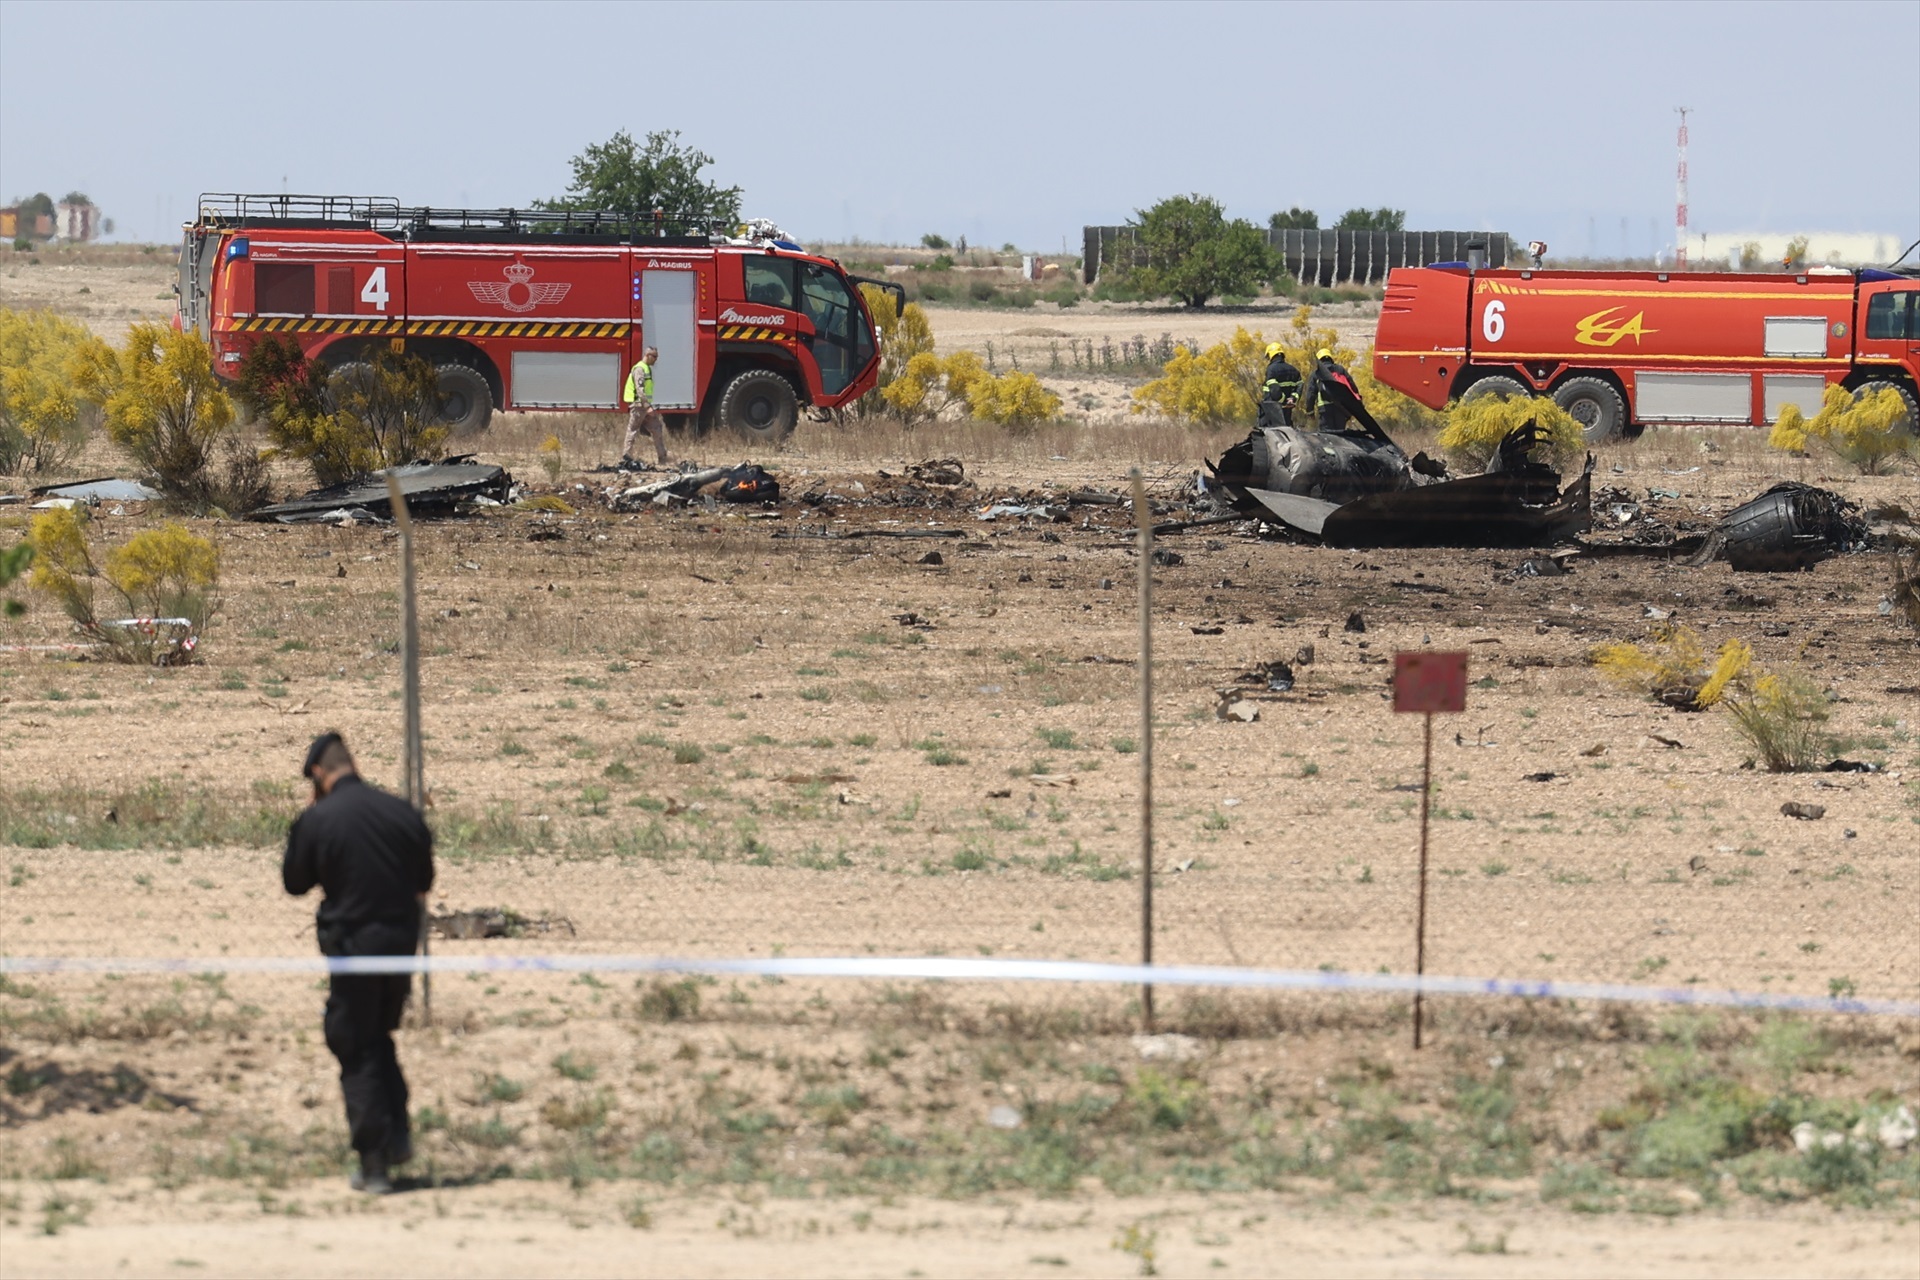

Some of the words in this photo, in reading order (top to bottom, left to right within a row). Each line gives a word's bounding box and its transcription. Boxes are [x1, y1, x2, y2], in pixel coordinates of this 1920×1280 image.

[660, 261, 692, 269] MAGIRUS
[361, 266, 389, 311] 4
[1482, 299, 1506, 343] 6
